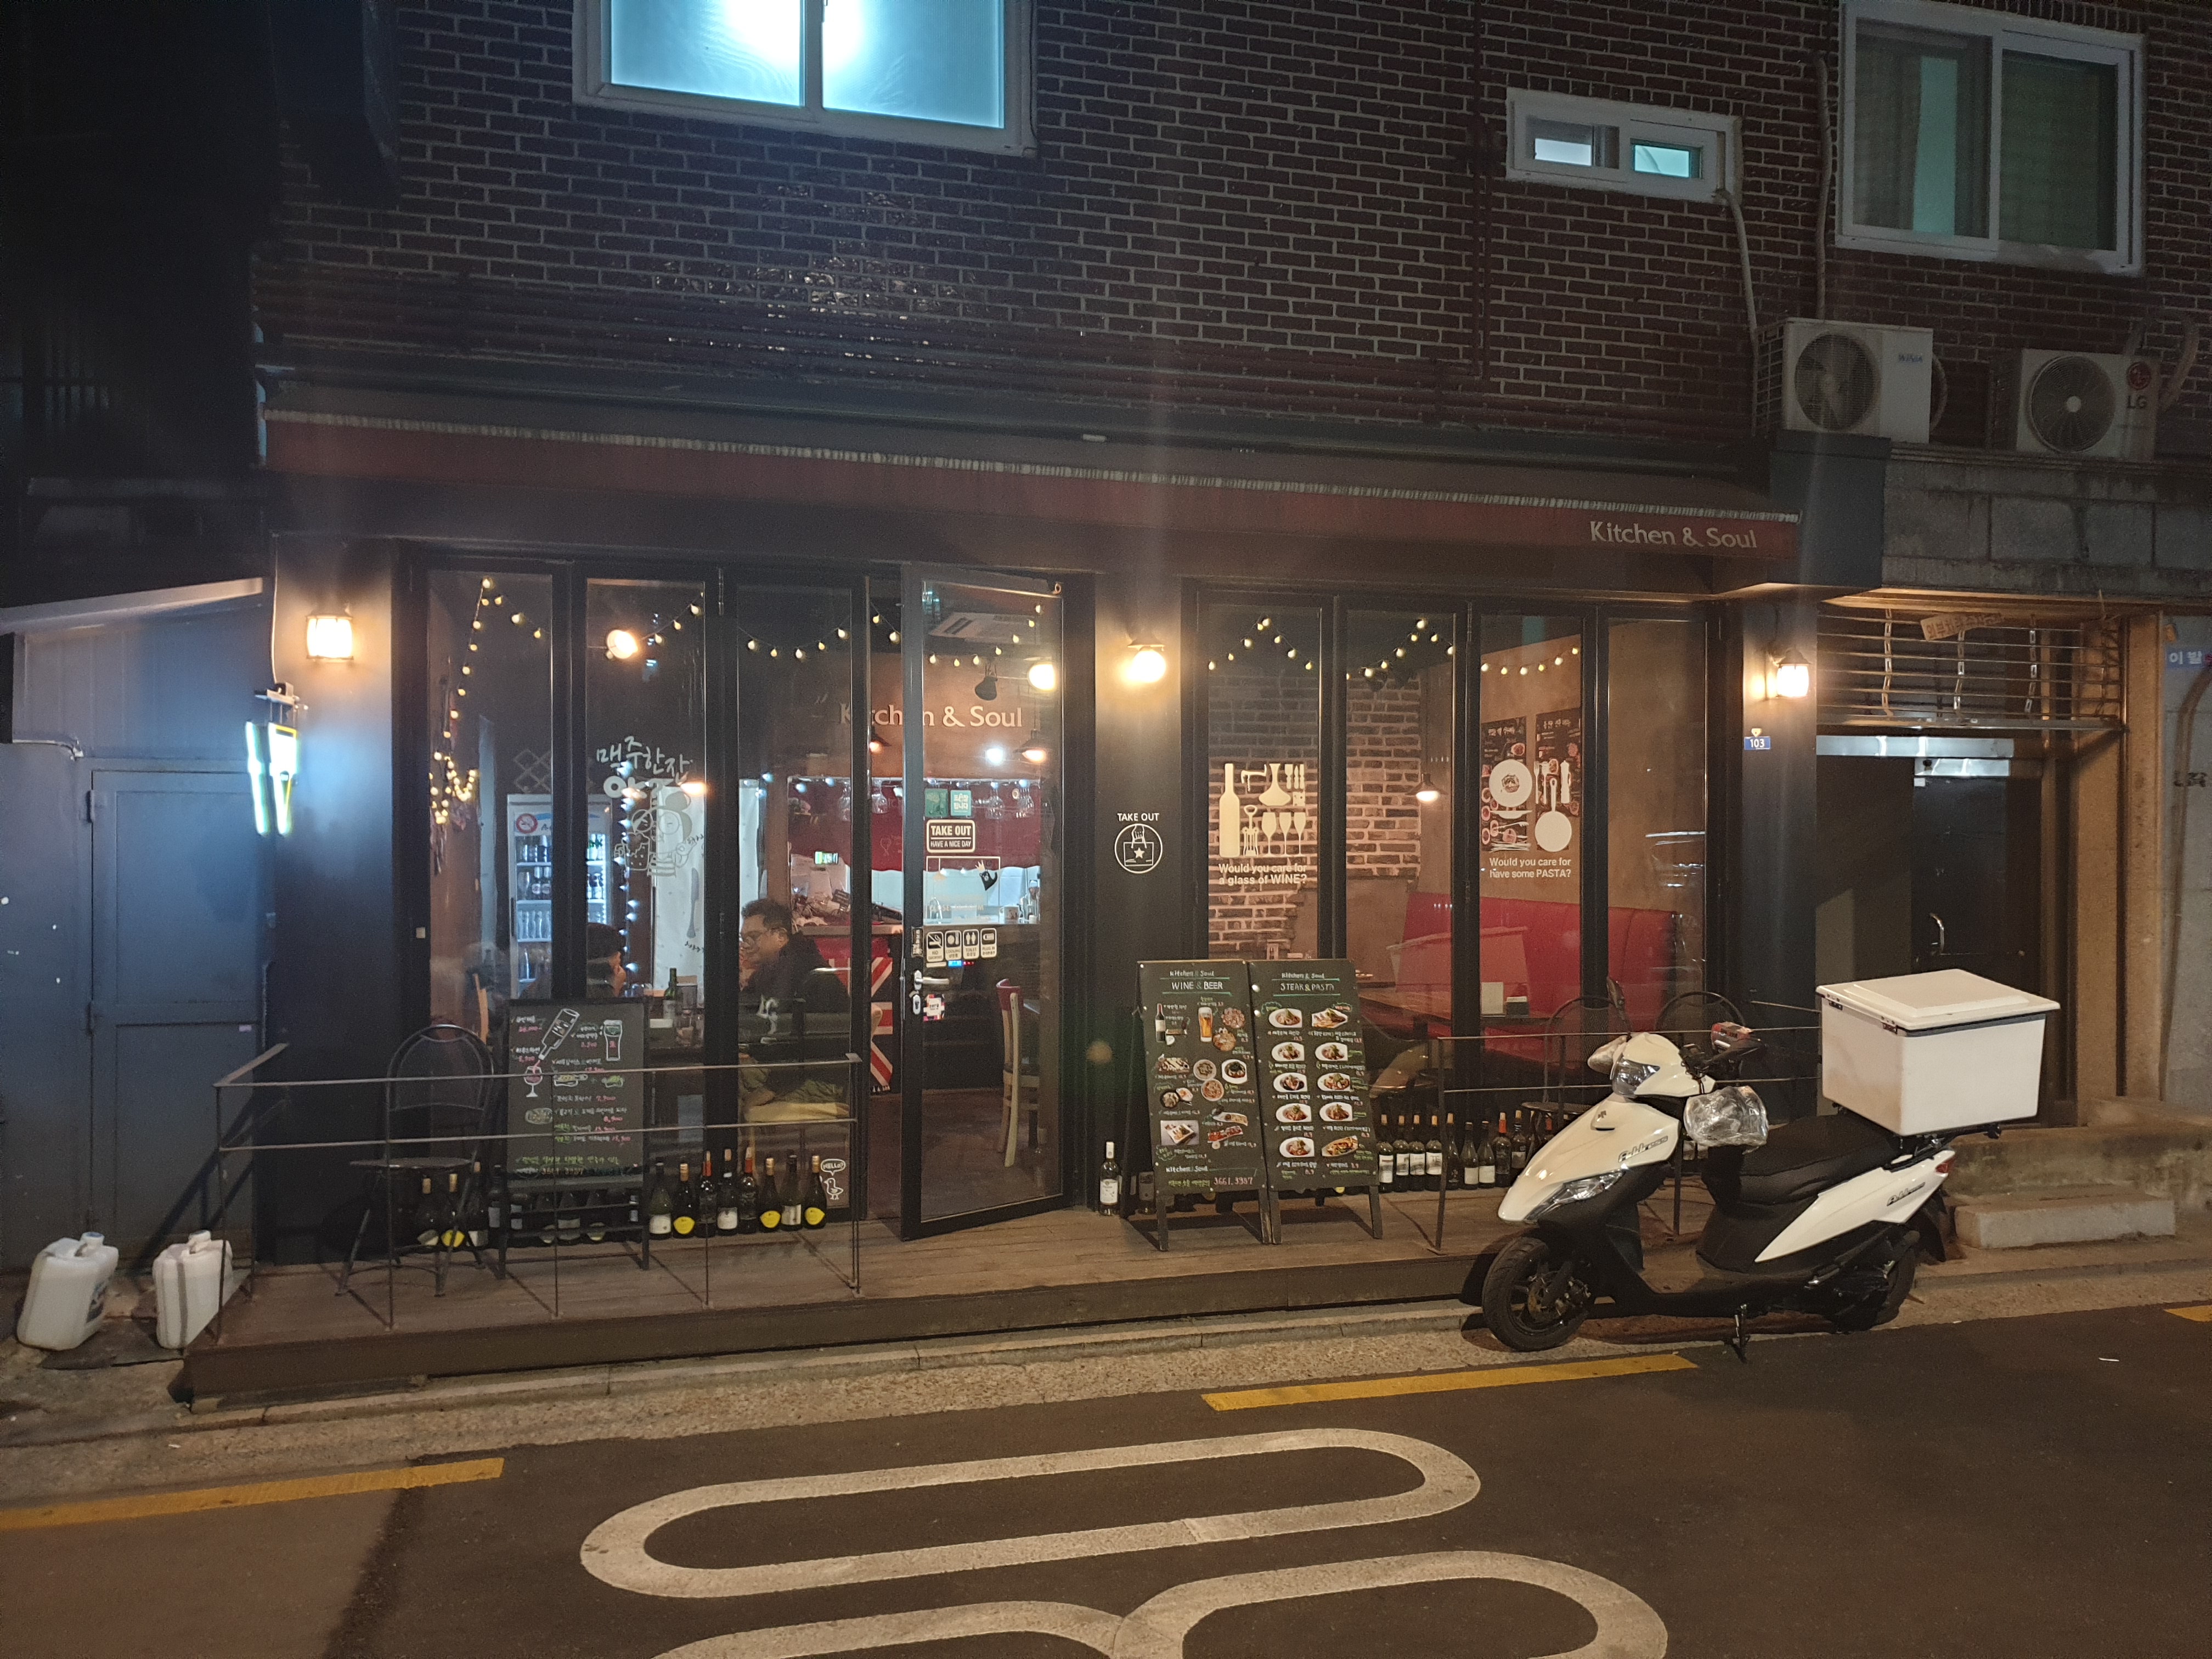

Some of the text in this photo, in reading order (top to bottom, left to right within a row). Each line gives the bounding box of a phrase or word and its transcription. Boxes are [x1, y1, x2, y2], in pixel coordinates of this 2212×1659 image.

[2127, 396, 2147, 409] LG
[1590, 521, 1757, 548] Kitchen & Soul
[943, 706, 966, 727] &
[970, 706, 1023, 727] Soul
[1750, 739, 1765, 748] 103
[1117, 812, 1160, 821] TAKE OUT
[930, 825, 972, 836] TAKE OUT
[1489, 857, 1518, 867] Would
[1520, 859, 1536, 867] you
[1559, 857, 1572, 866] for
[1218, 863, 1307, 874] Would you care for
[1489, 869, 1510, 878] have
[1536, 868, 1572, 878] PASTA?
[1227, 875, 1255, 886] glass
[1258, 874, 1268, 884] of
[1270, 873, 1307, 884] WINE?
[1172, 981, 1223, 990] WINE & BEER
[1214, 1177, 1254, 1186] 3661.3987
